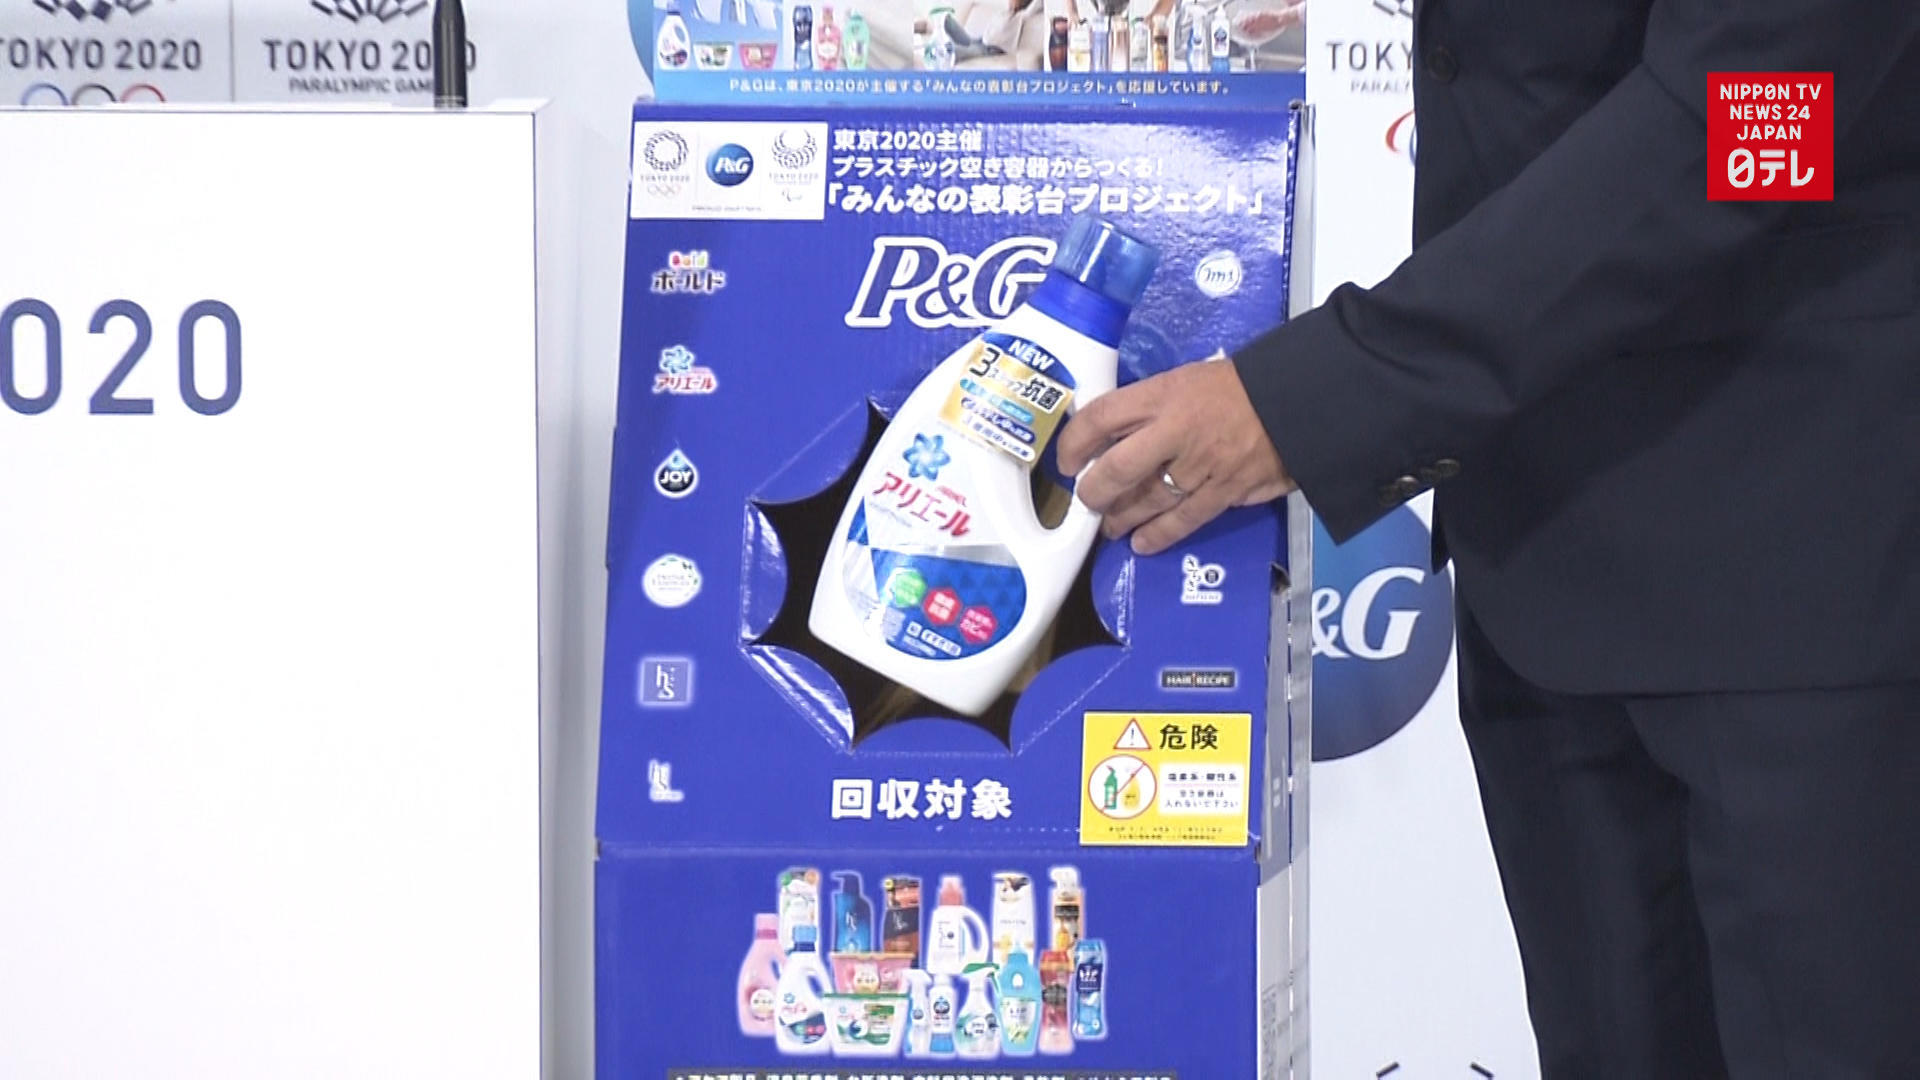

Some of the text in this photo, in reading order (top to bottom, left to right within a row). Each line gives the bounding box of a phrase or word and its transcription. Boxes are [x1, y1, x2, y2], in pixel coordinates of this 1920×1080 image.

[0, 38, 201, 70] OKYO 2020
[262, 39, 477, 71] TOKYO 200
[1326, 42, 1412, 71] TOKY
[290, 77, 391, 93] PARALYMPIC
[833, 129, 982, 153] 東京2020主催
[714, 157, 751, 175] P&G
[828, 183, 1264, 216] 「みんなの表彰台プロジェクト」
[653, 271, 724, 292] ボールド
[845, 236, 1058, 328] P&G
[1007, 338, 1055, 372] NEW
[656, 374, 714, 392] アリエール
[660, 470, 692, 485] JOY
[872, 471, 972, 537] アリエール
[1312, 566, 1425, 660] &G
[1159, 723, 1219, 751] 危険
[831, 778, 1013, 820] 回収対象
